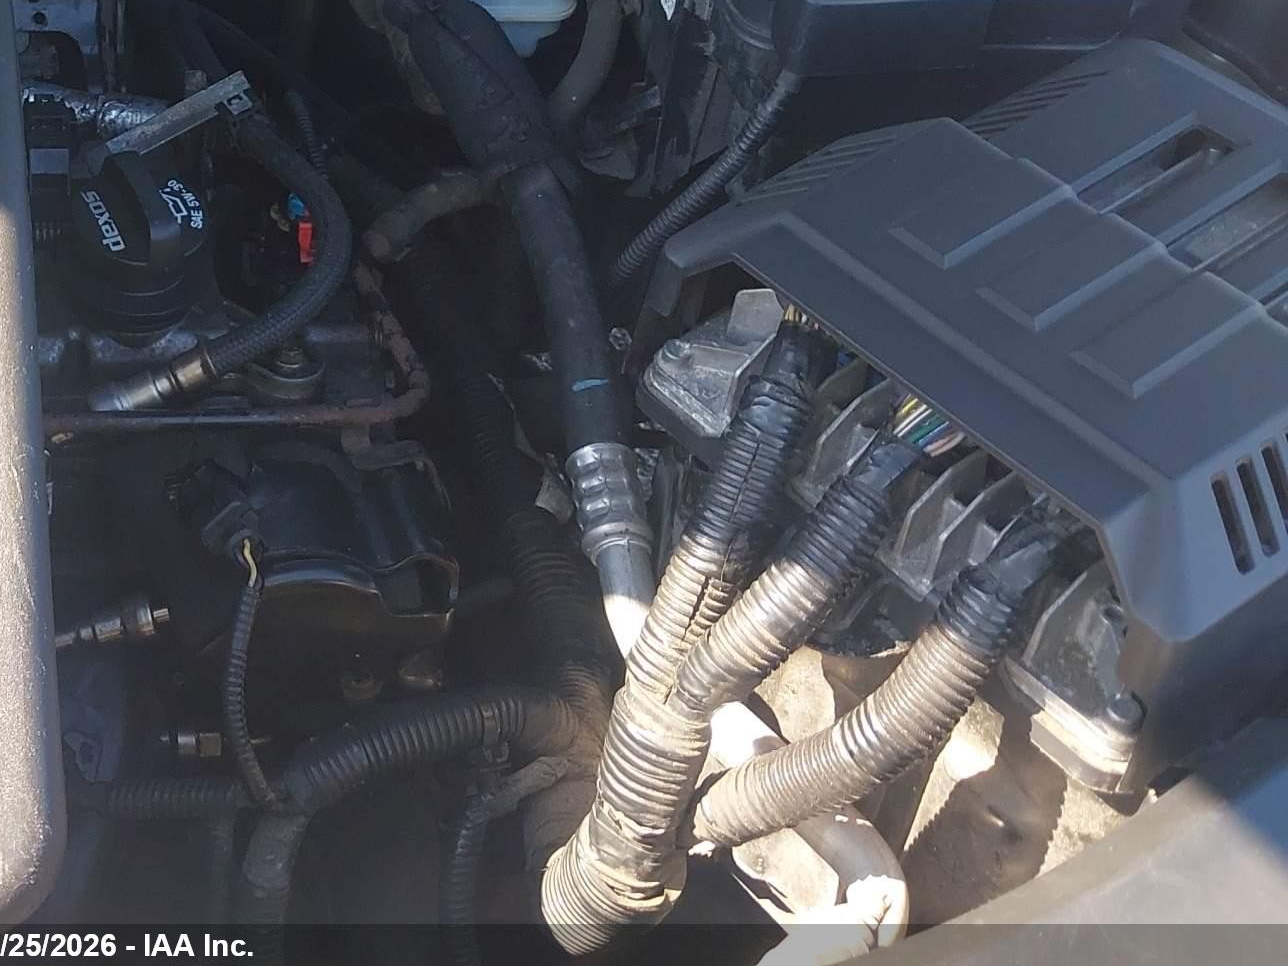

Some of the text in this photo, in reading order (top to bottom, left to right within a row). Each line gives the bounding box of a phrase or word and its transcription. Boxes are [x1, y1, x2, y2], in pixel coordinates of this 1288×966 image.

[80, 190, 126, 252] dexos
[167, 179, 203, 229] SAE 5W-30
